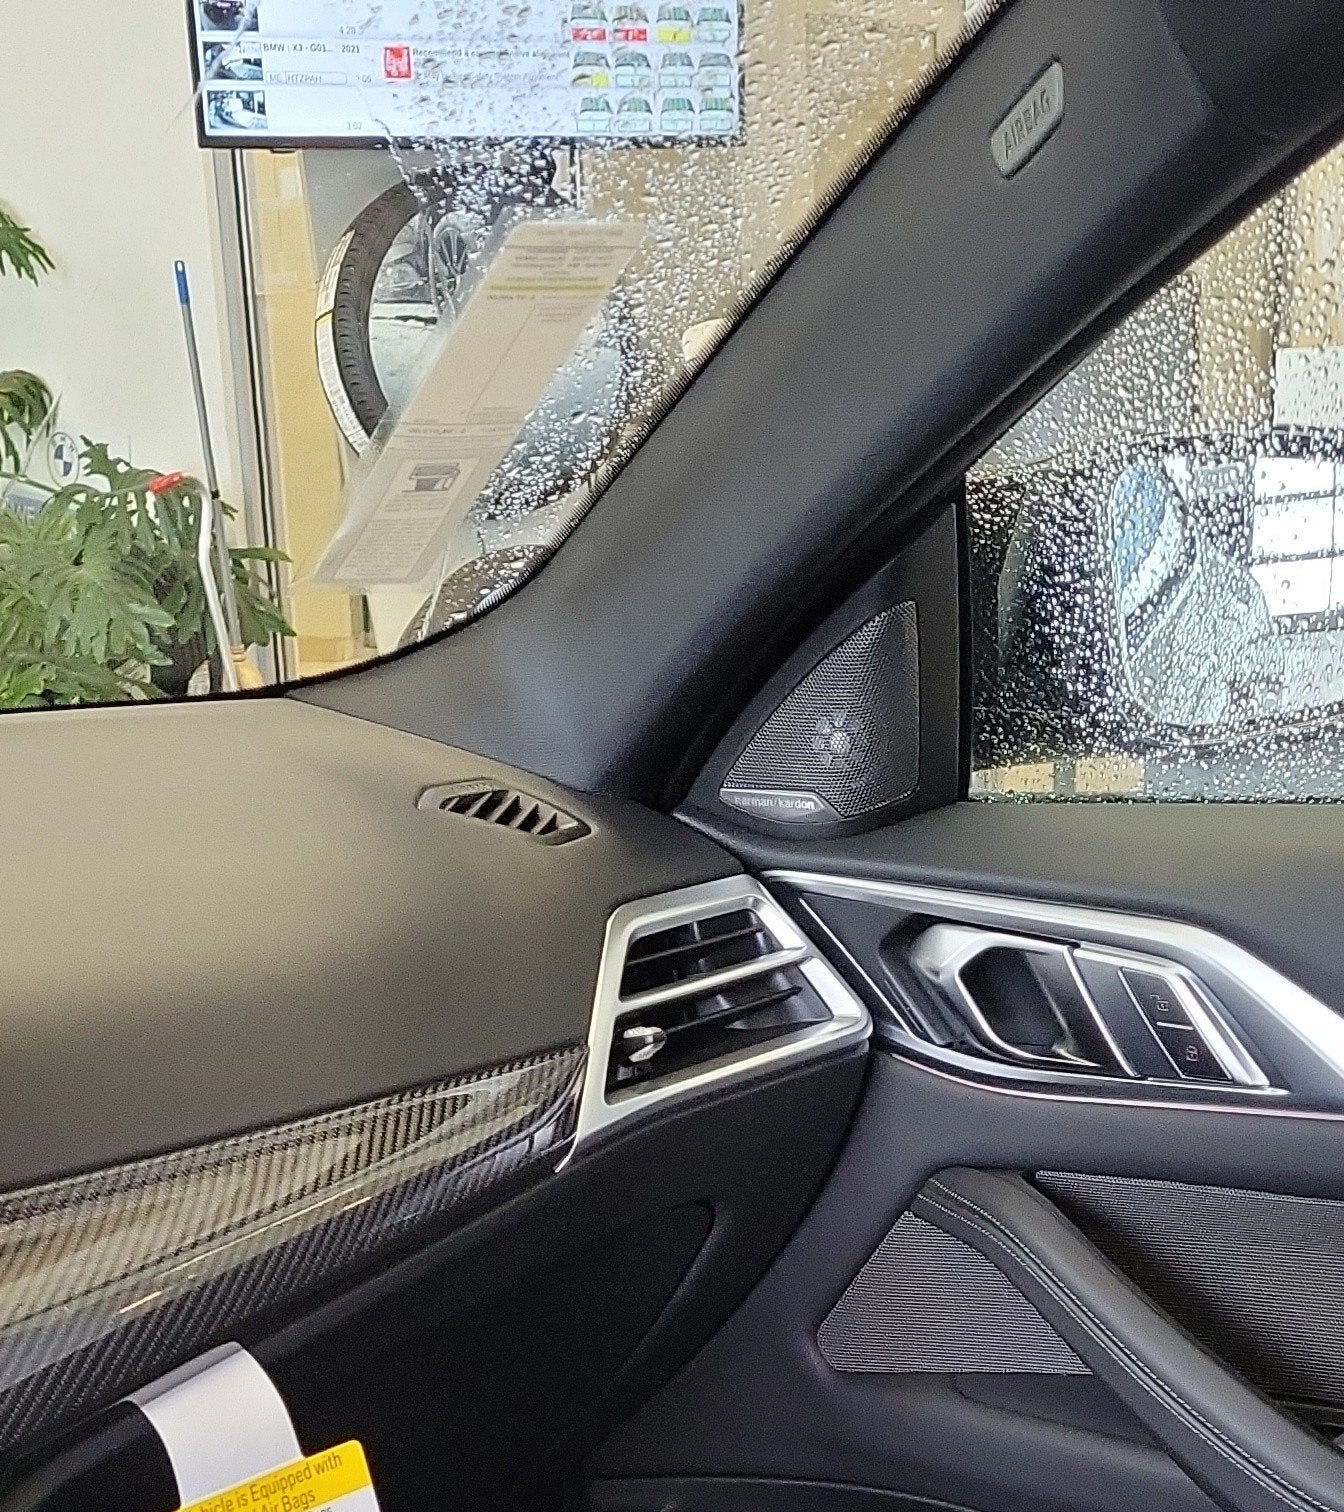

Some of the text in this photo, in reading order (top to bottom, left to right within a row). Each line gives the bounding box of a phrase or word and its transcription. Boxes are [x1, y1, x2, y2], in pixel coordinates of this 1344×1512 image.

[1001, 88, 1051, 162] AIRBAG
[237, 1491, 249, 1508] is
[249, 1462, 313, 1503] Equipped
[313, 1452, 343, 1476] with
[281, 1489, 316, 1512] Bags
